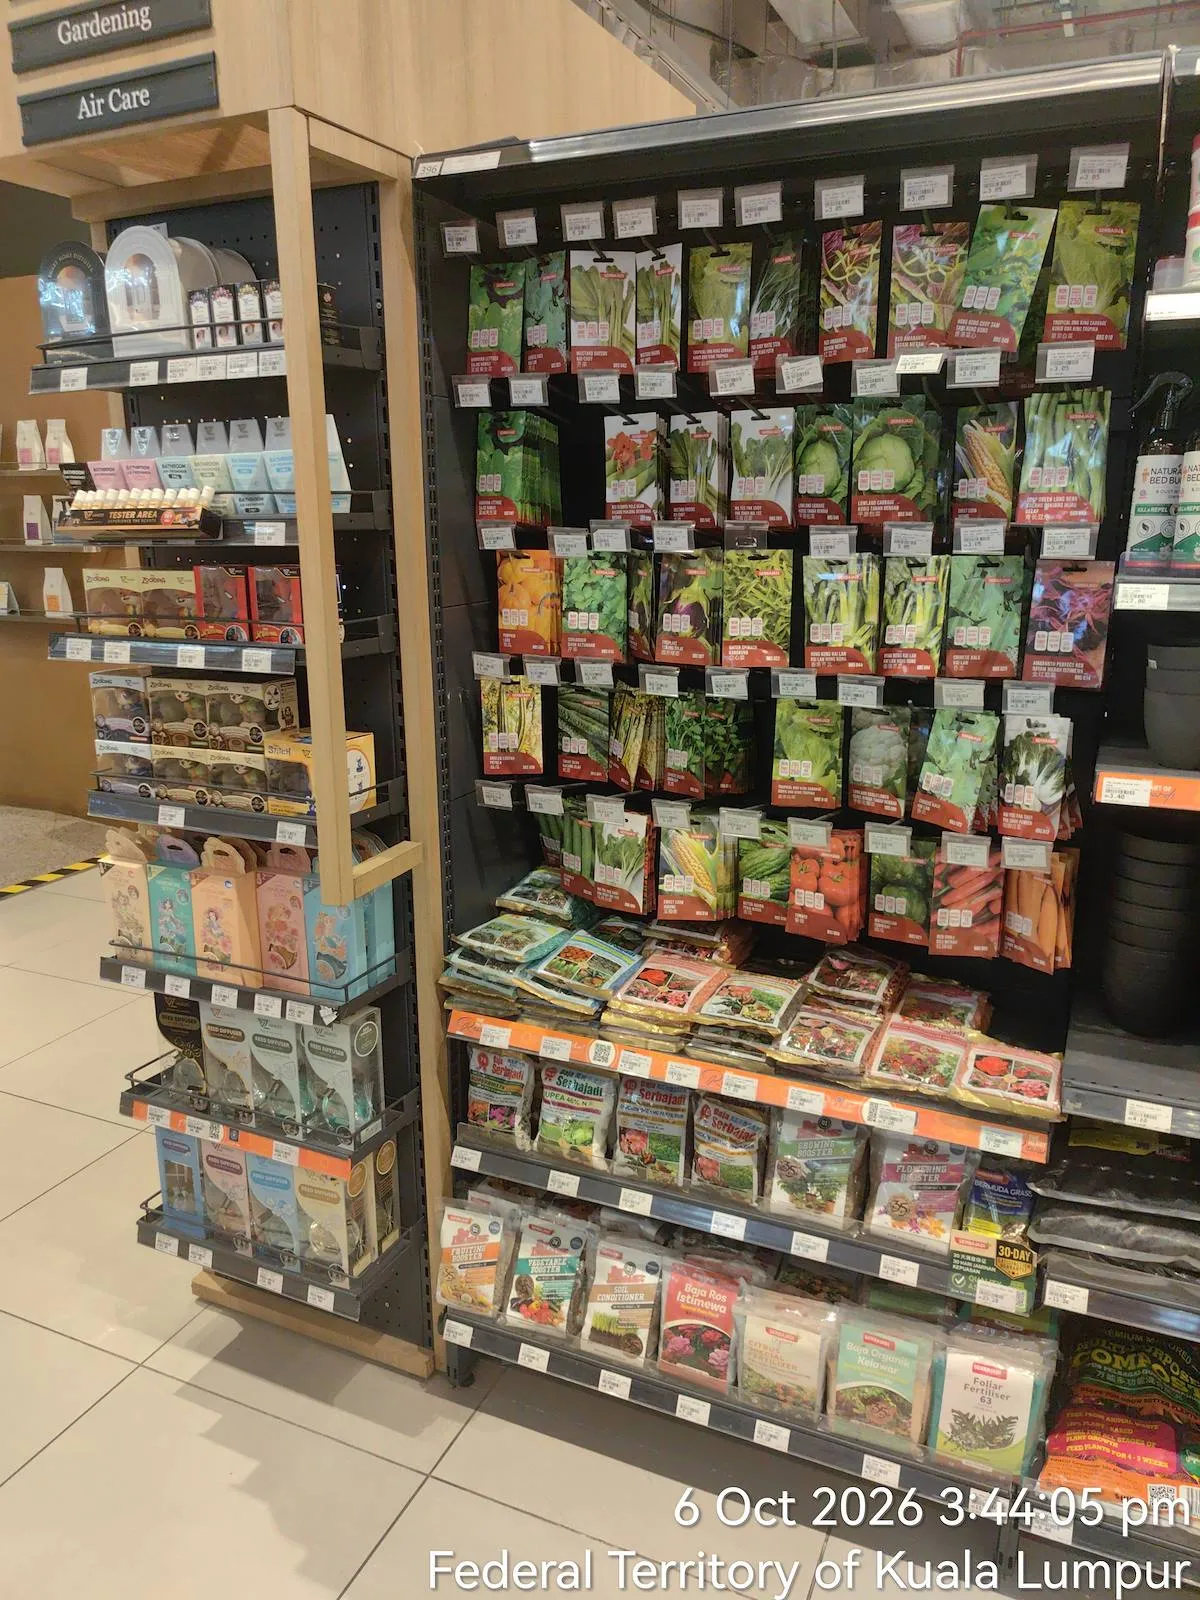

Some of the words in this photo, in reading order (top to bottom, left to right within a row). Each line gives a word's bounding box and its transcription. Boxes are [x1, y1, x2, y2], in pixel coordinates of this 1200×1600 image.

[57, 5, 152, 45] Gardening
[77, 92, 104, 120] Air
[108, 87, 150, 113] Care
[1151, 464, 1182, 475] NATURA
[109, 511, 136, 519] TESTER
[138, 511, 158, 519] AREA
[556, 1076, 603, 1096] Serbajadi
[639, 1089, 686, 1105] Serbajadi
[896, 1164, 947, 1173] FLOWERING
[901, 1173, 940, 1182] BOOSTER
[975, 1180, 1009, 1194] BERMUDA
[998, 1246, 1031, 1261] 30-DAY
[597, 1292, 644, 1301] CONDITIONER
[684, 1283, 707, 1297] Baja
[709, 1288, 728, 1302] Ros
[676, 1290, 728, 1313] Istimewa
[847, 1341, 869, 1355] Baja
[973, 1377, 1003, 1391] Foliar
[963, 1383, 1011, 1401] Fertiliser
[980, 1396, 992, 1406] 63
